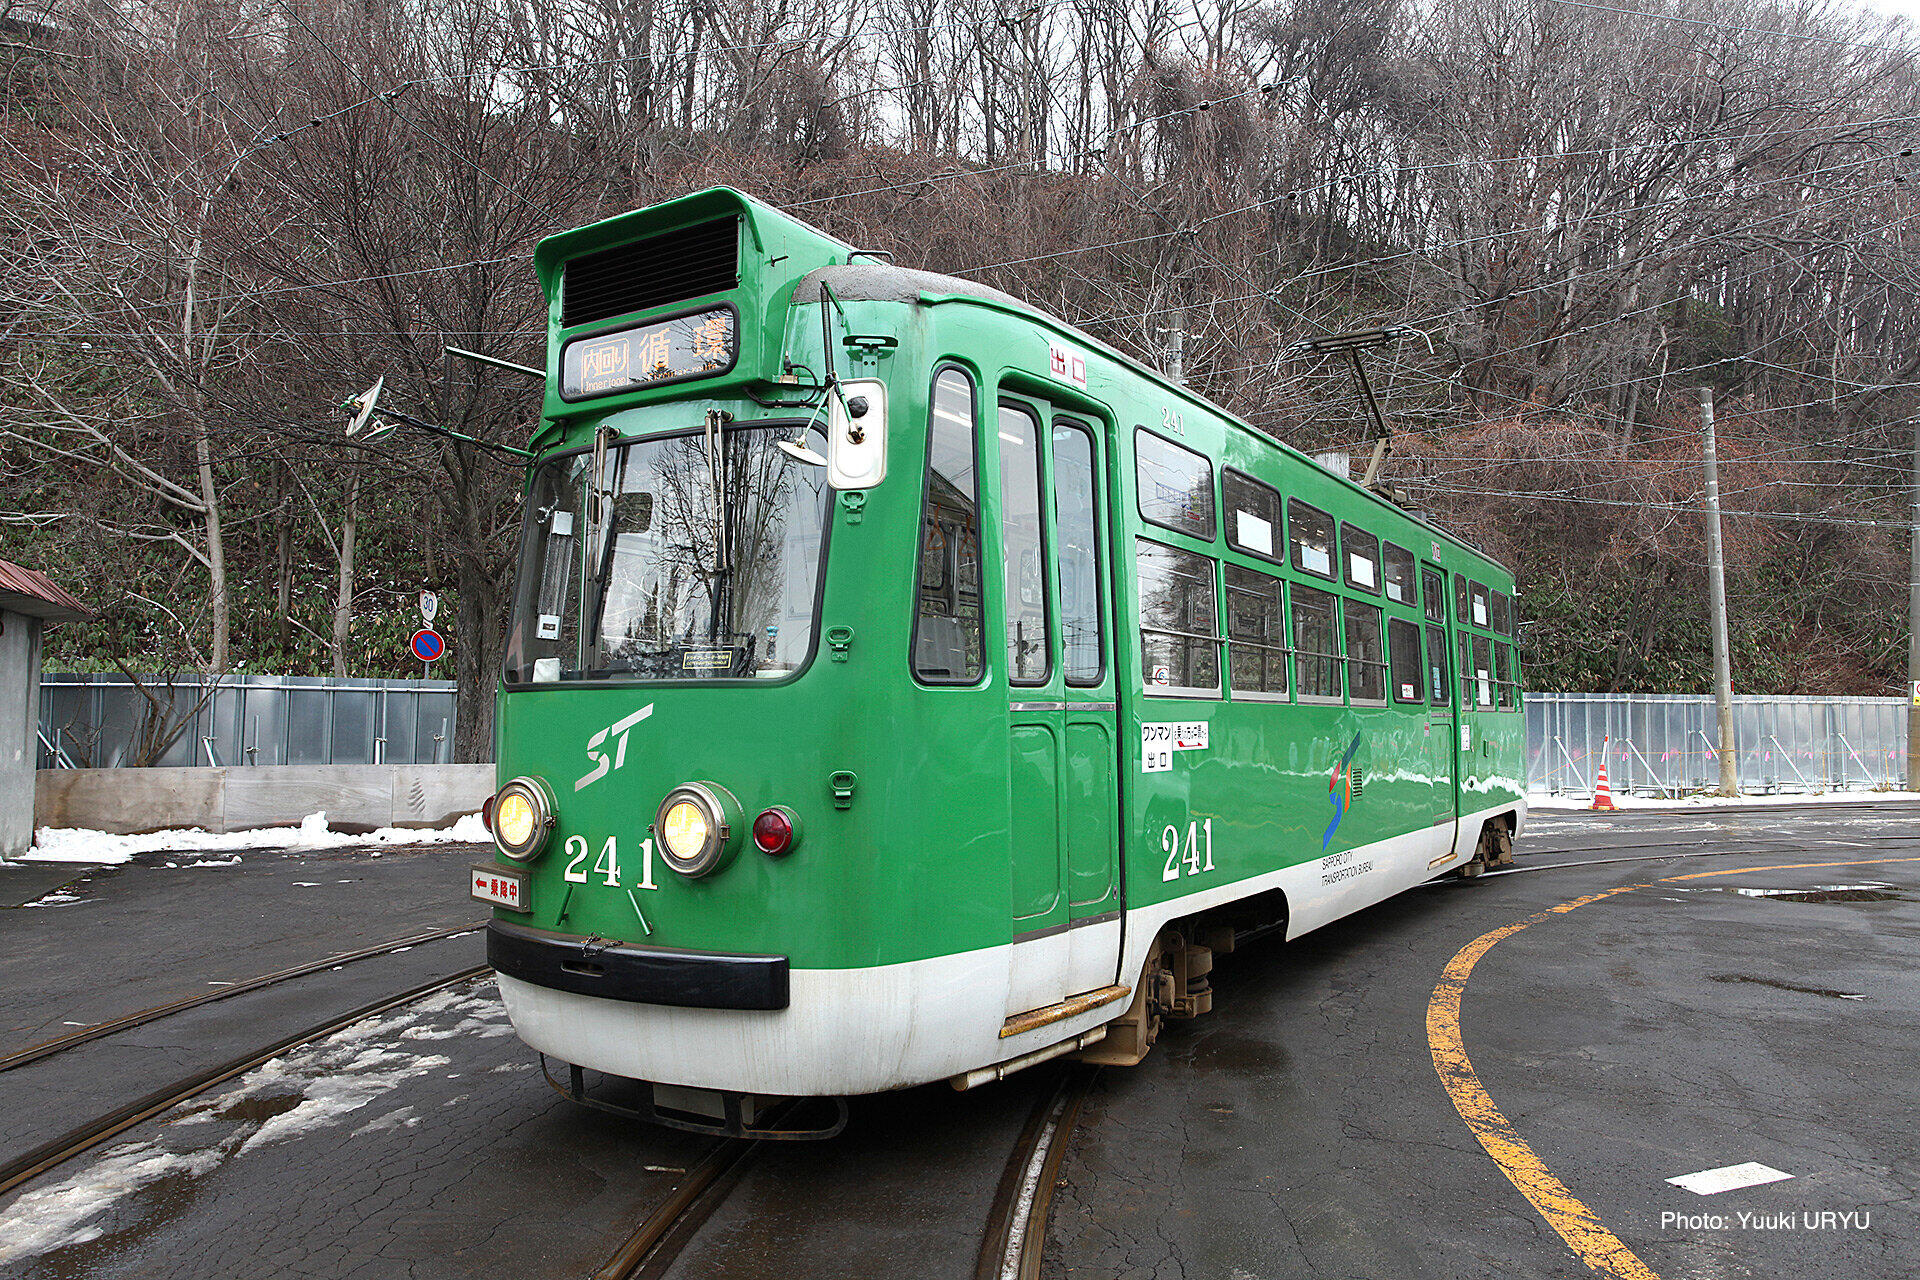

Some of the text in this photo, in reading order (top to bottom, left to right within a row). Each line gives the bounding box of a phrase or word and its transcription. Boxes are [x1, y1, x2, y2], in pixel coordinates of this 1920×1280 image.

[583, 342, 628, 379] 内回り
[1050, 347, 1086, 384] 出口
[1161, 405, 1185, 437] 241
[423, 595, 434, 613] 30
[1142, 726, 1171, 742] ワンマン
[1147, 751, 1167, 769] 出口
[563, 834, 659, 891] 241
[1161, 817, 1216, 883] 241
